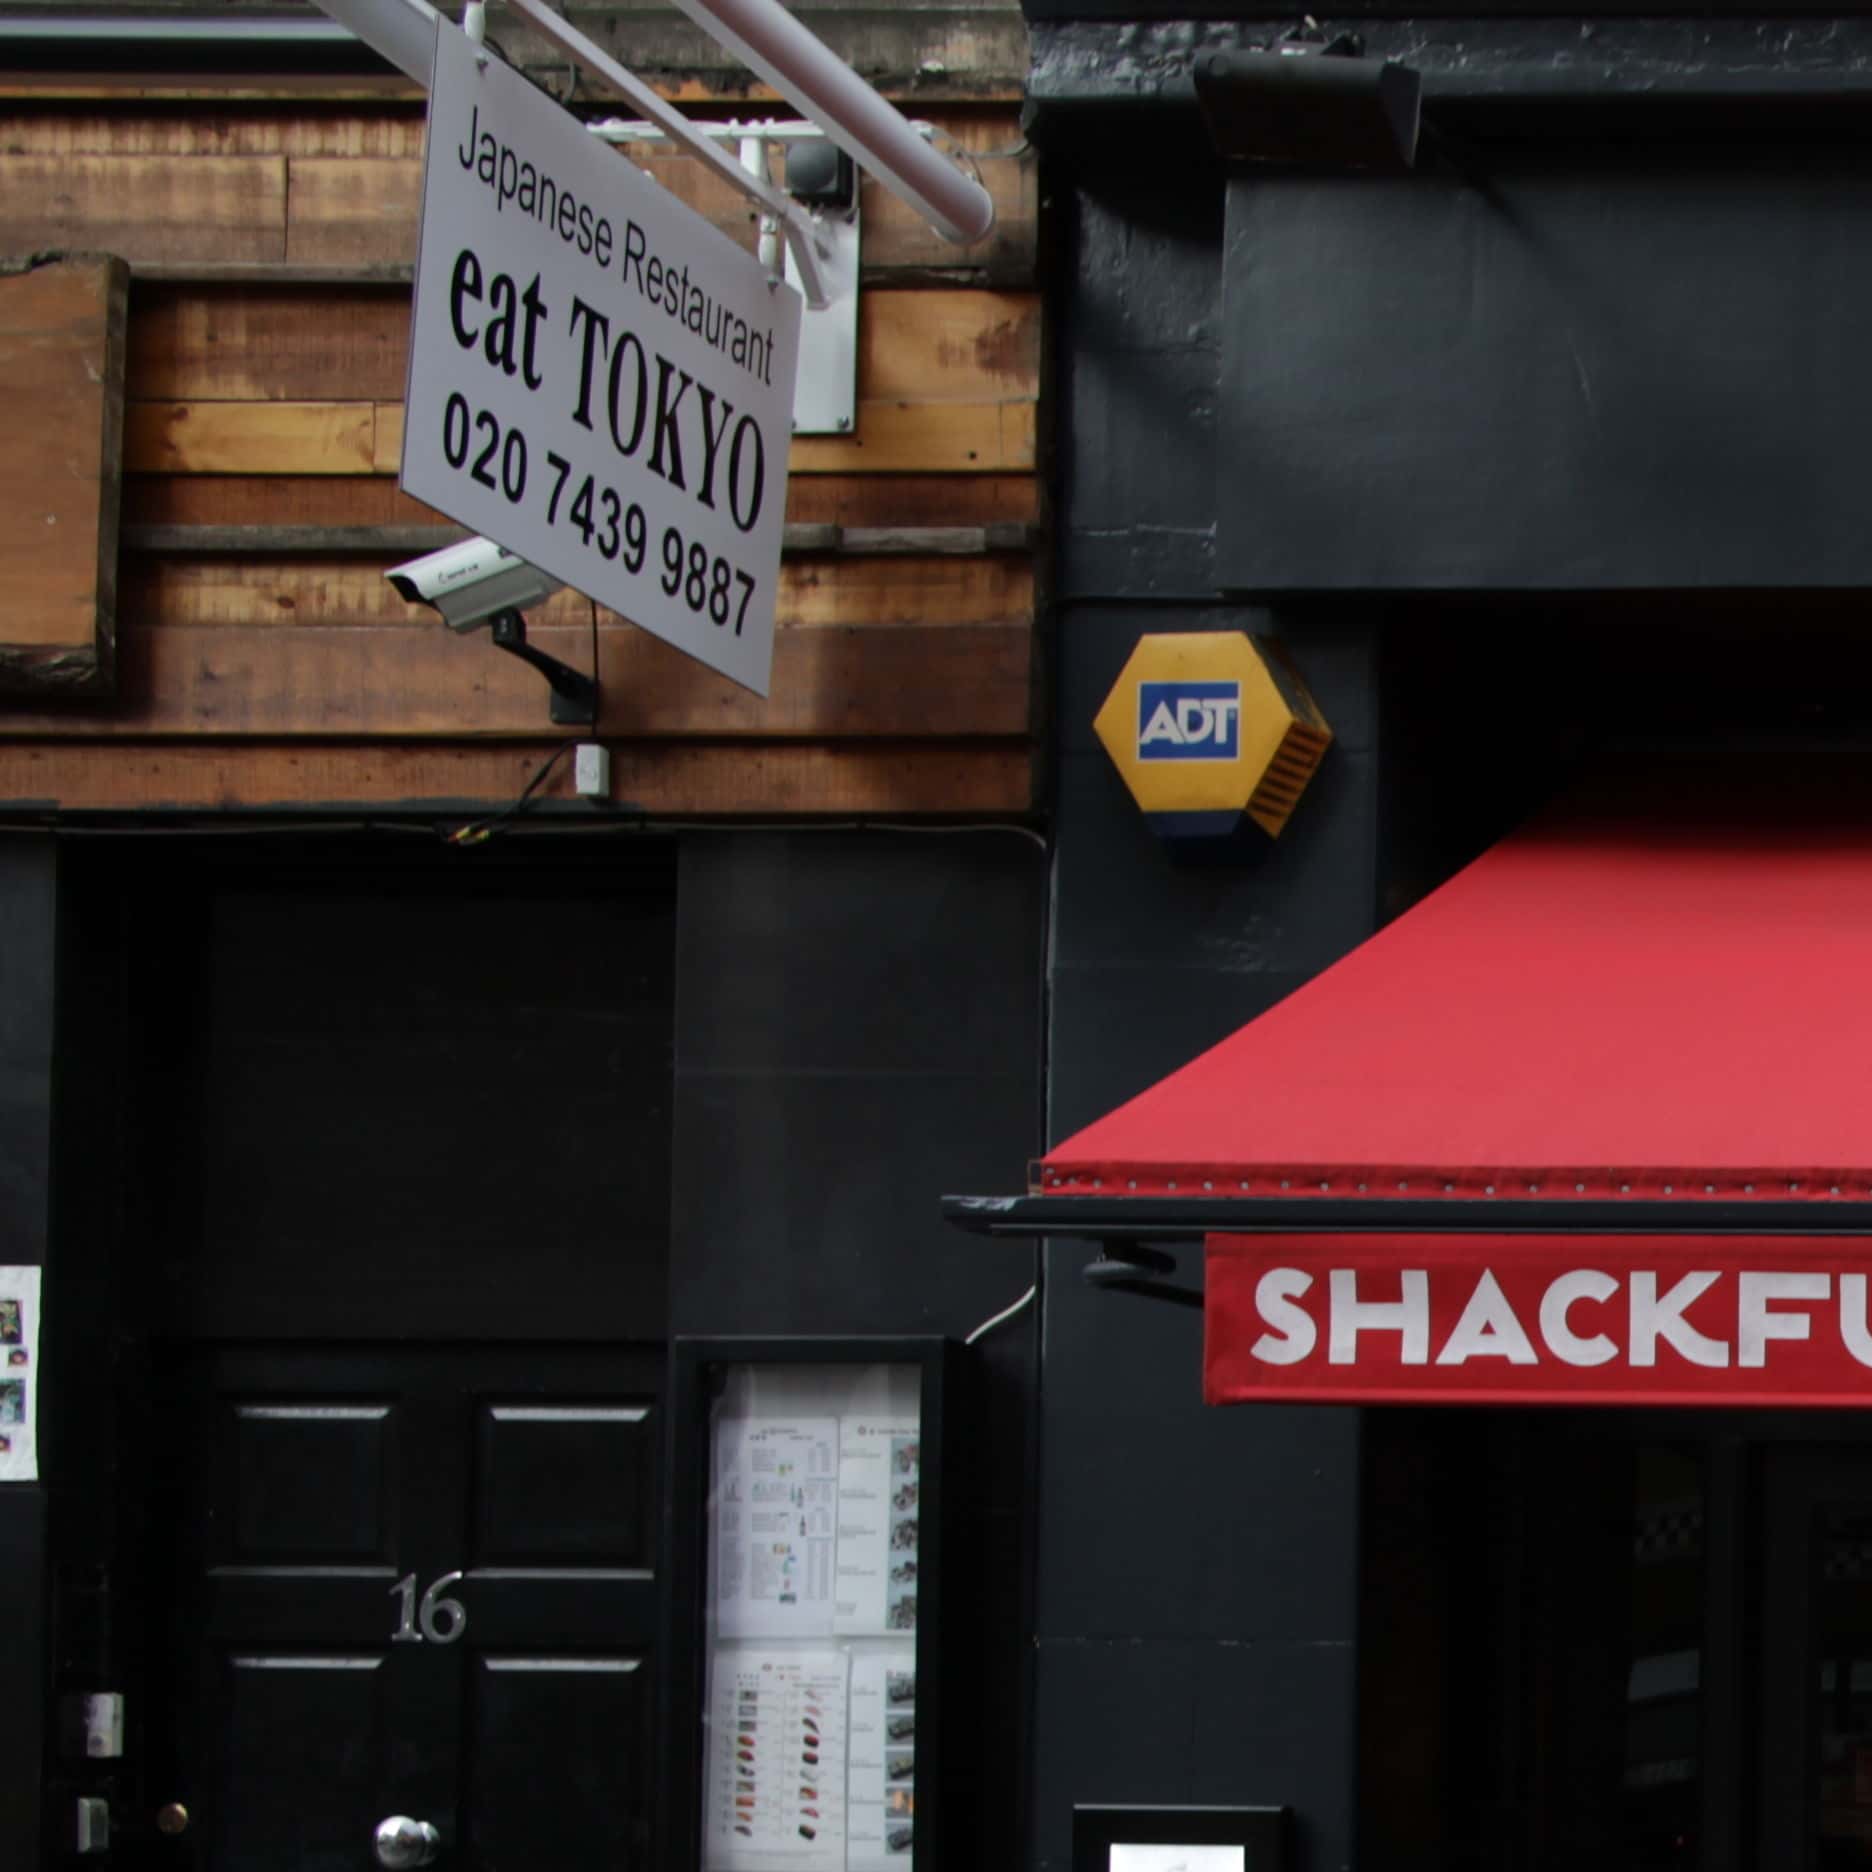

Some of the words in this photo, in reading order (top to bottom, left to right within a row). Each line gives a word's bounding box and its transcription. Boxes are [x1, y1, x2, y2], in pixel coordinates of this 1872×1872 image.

[458, 105, 612, 270] Japanese
[624, 223, 774, 388] Restaurant
[450, 248, 547, 391] eat
[568, 295, 765, 533] TOKYO
[443, 392, 528, 505] 020
[546, 452, 646, 575] 7439
[663, 527, 756, 638] 9887
[1140, 697, 1239, 745] ADT
[388, 1570, 467, 1643] 16
